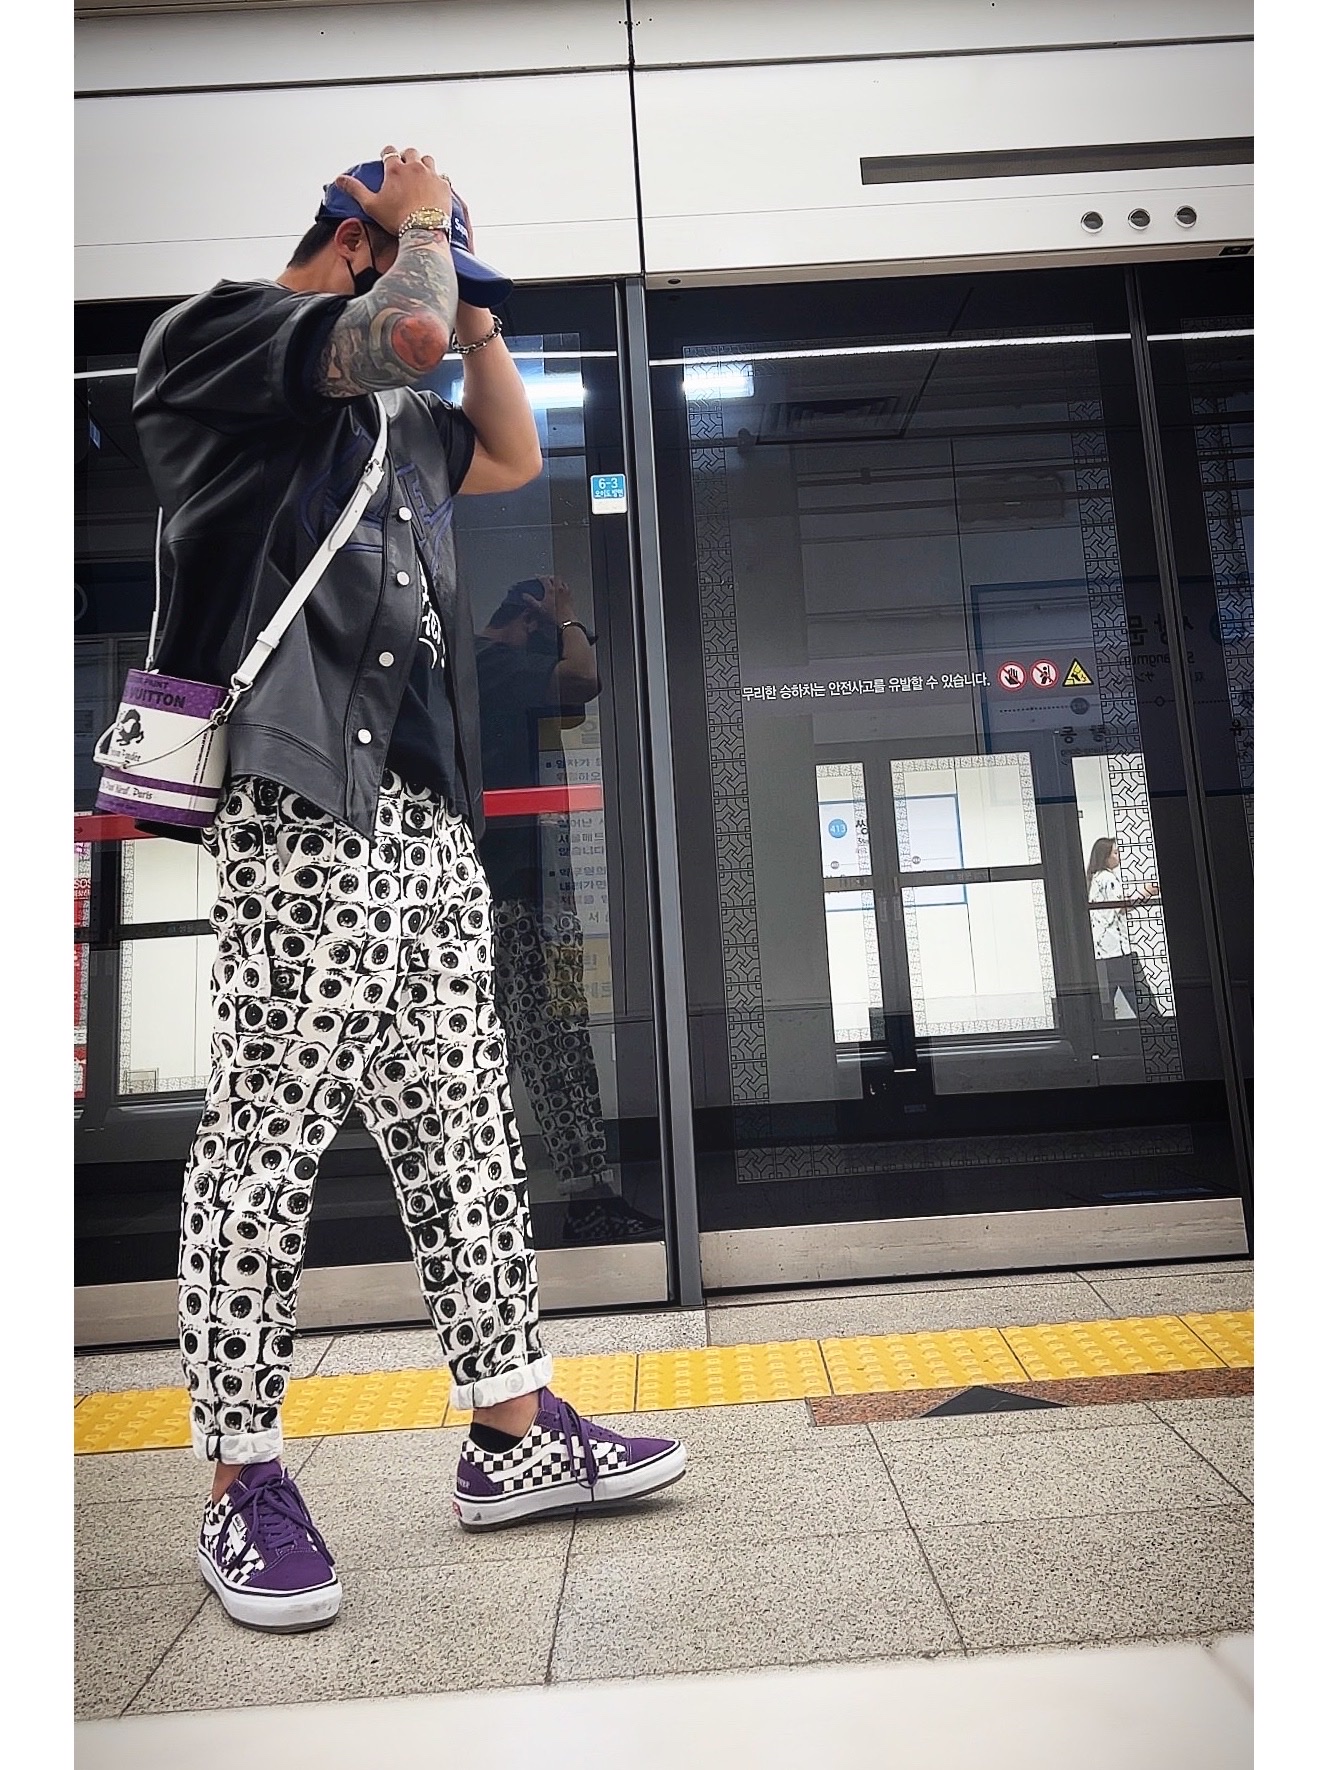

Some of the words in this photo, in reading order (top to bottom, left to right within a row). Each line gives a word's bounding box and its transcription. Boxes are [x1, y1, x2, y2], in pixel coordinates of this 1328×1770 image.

[598, 477, 618, 489] 6-3
[741, 685, 777, 701] 무리한
[779, 682, 826, 700] 승하차는
[828, 678, 886, 697] 안전사고를
[888, 675, 924, 693] 유발할
[925, 675, 938, 690] 수
[941, 671, 991, 689] 있습니다.
[830, 824, 846, 834] 413
